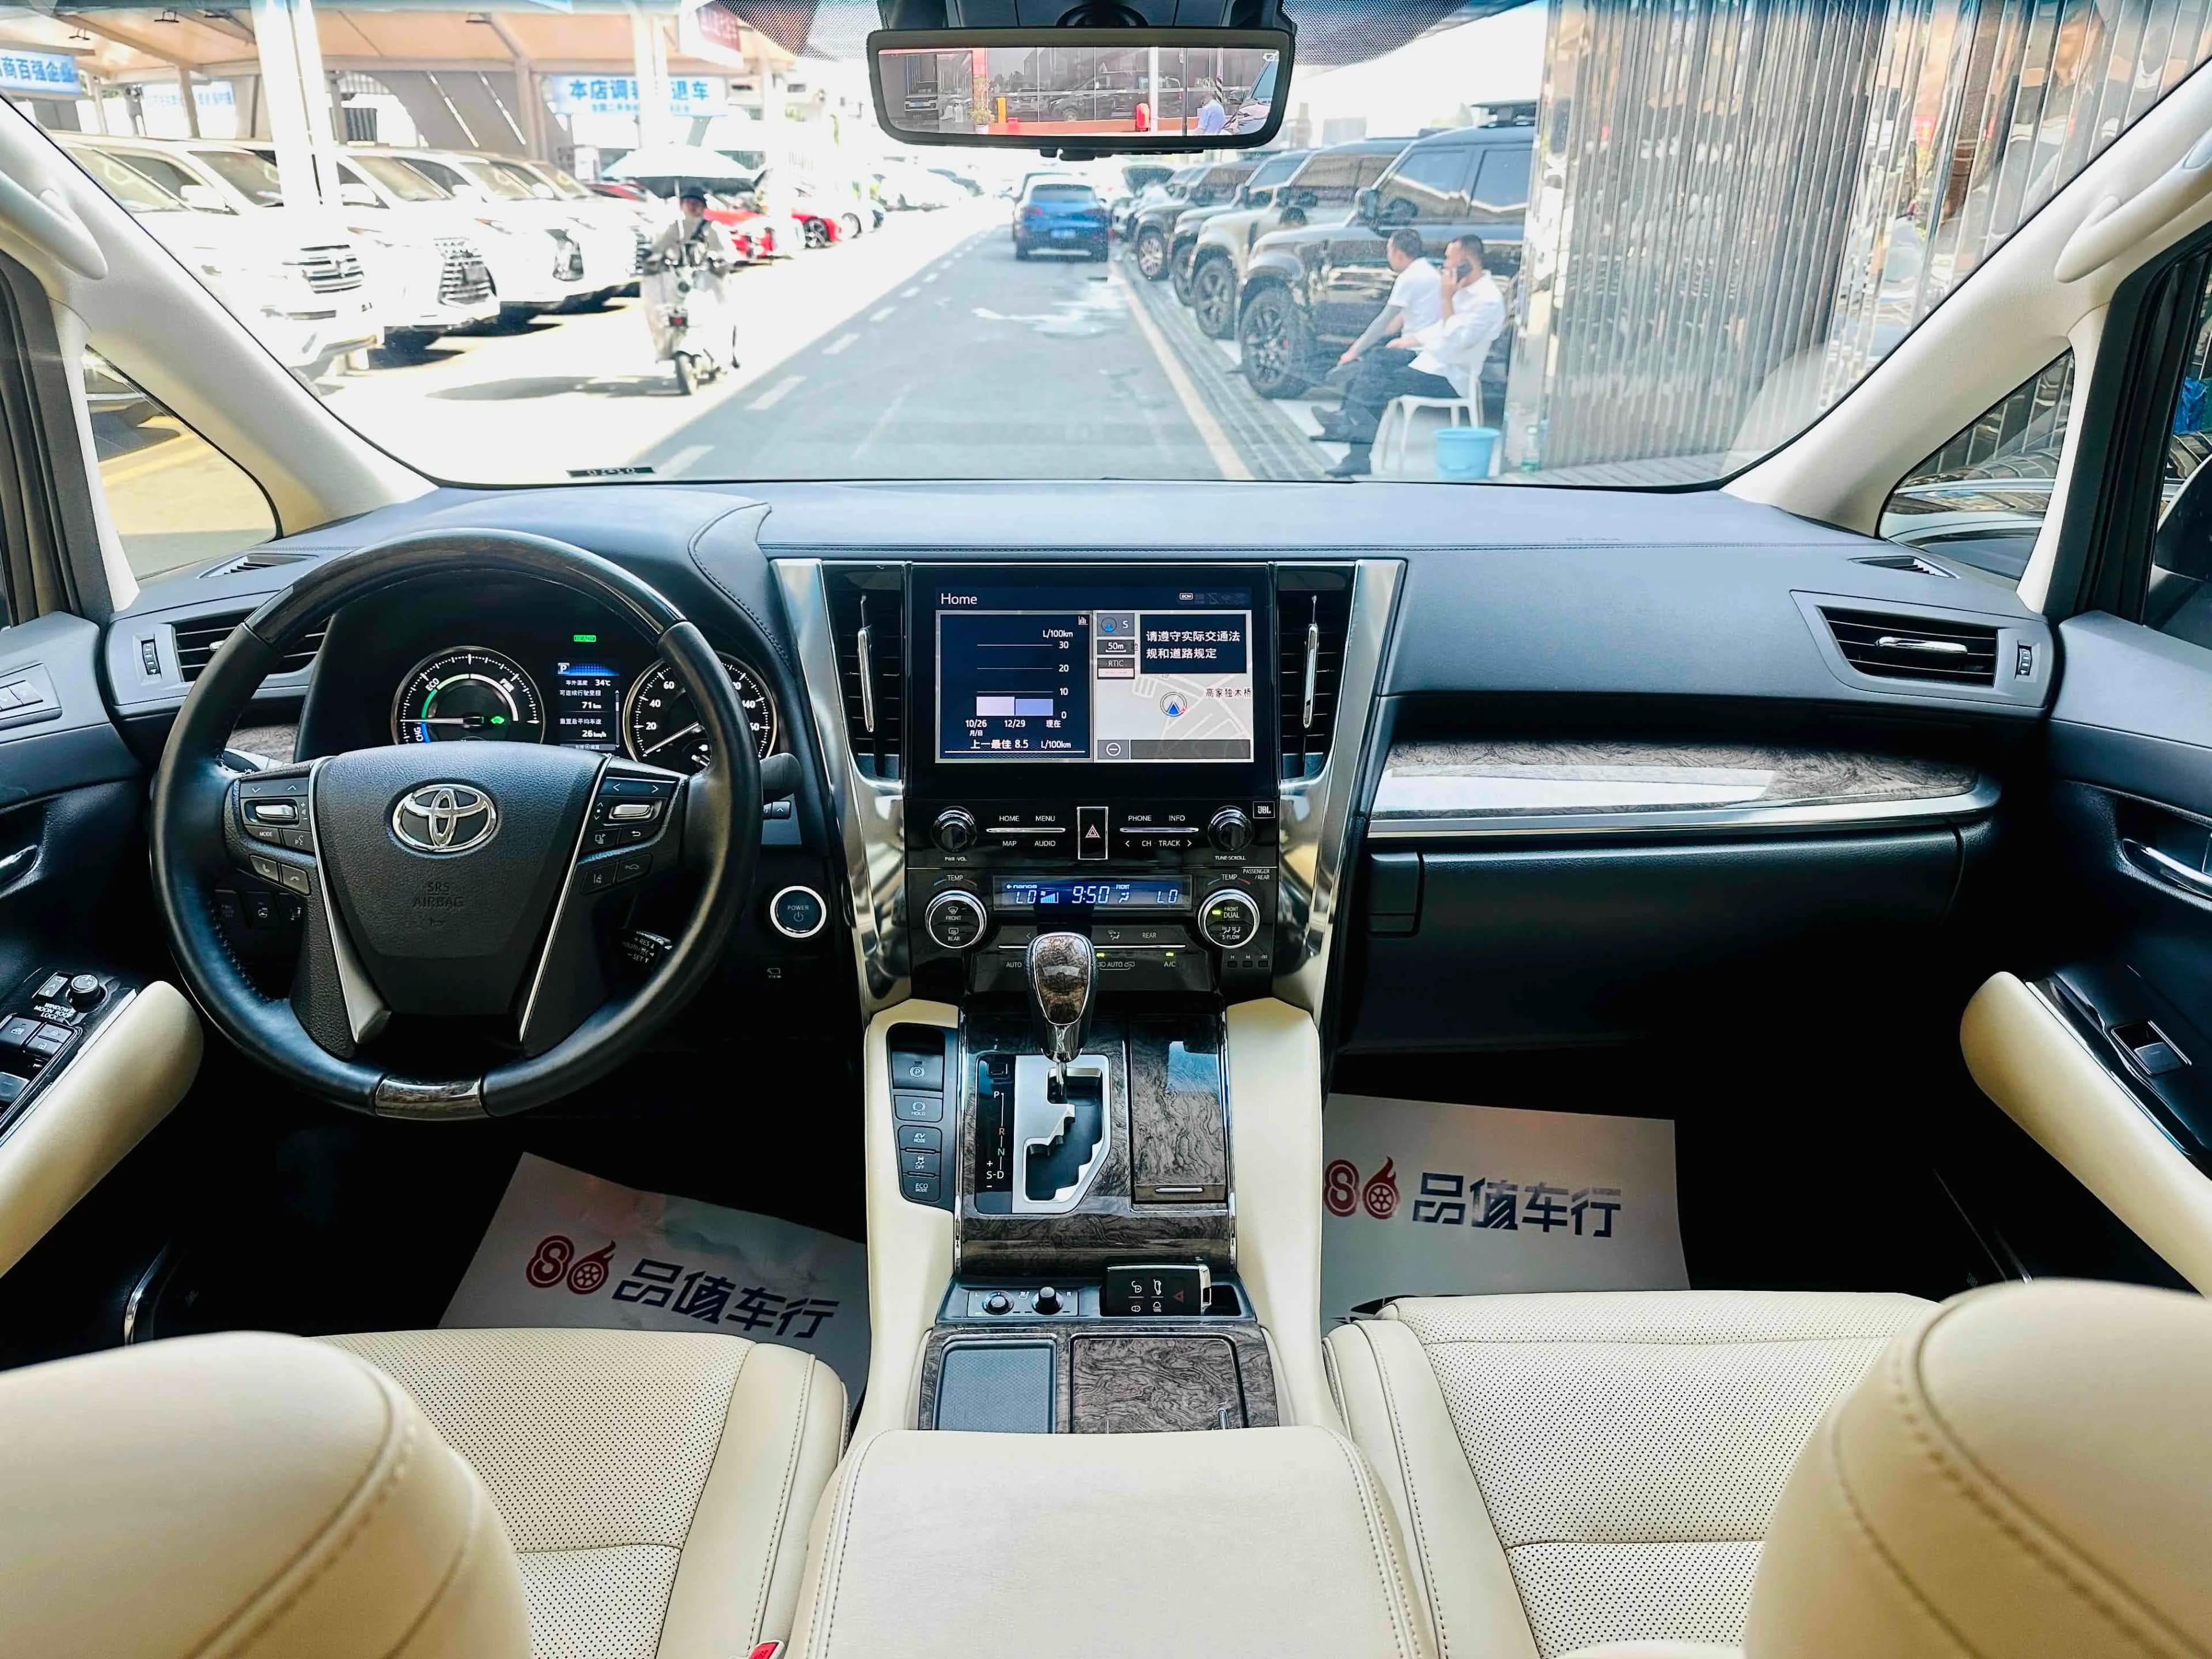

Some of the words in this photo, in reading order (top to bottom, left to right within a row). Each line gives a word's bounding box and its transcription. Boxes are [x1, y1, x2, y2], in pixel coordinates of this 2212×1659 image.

[0, 56, 75, 82] 商百强企业
[569, 79, 709, 100] 本店调退车
[941, 593, 978, 605] Home
[1122, 620, 1128, 629] S
[1042, 628, 1073, 639] L/100km
[1146, 631, 1240, 642] 请遵守实际交通法
[1058, 641, 1069, 649] 30
[1108, 642, 1124, 650] 50m
[1146, 648, 1217, 659] 规和道路规定
[1058, 664, 1069, 672] 20
[425, 678, 440, 691] ECO
[663, 681, 675, 690] 60
[649, 699, 661, 707] 40
[1061, 711, 1067, 719] 0
[646, 722, 657, 730] 20
[965, 719, 987, 728] 10/26
[1004, 719, 1026, 728] 12/29
[1046, 719, 1061, 728] 现在
[414, 726, 423, 742] CHG
[970, 740, 1012, 749] 上一最佳
[1014, 740, 1029, 749] 8.5
[1041, 740, 1071, 749] L/100km
[1257, 806, 1272, 815] JBL
[427, 882, 449, 892] SRS
[1071, 886, 1110, 904] 9:50
[33, 1005, 54, 1014] MOON
[1412, 1172, 1622, 1237] 品值车行
[612, 1258, 840, 1338] 品值车行
